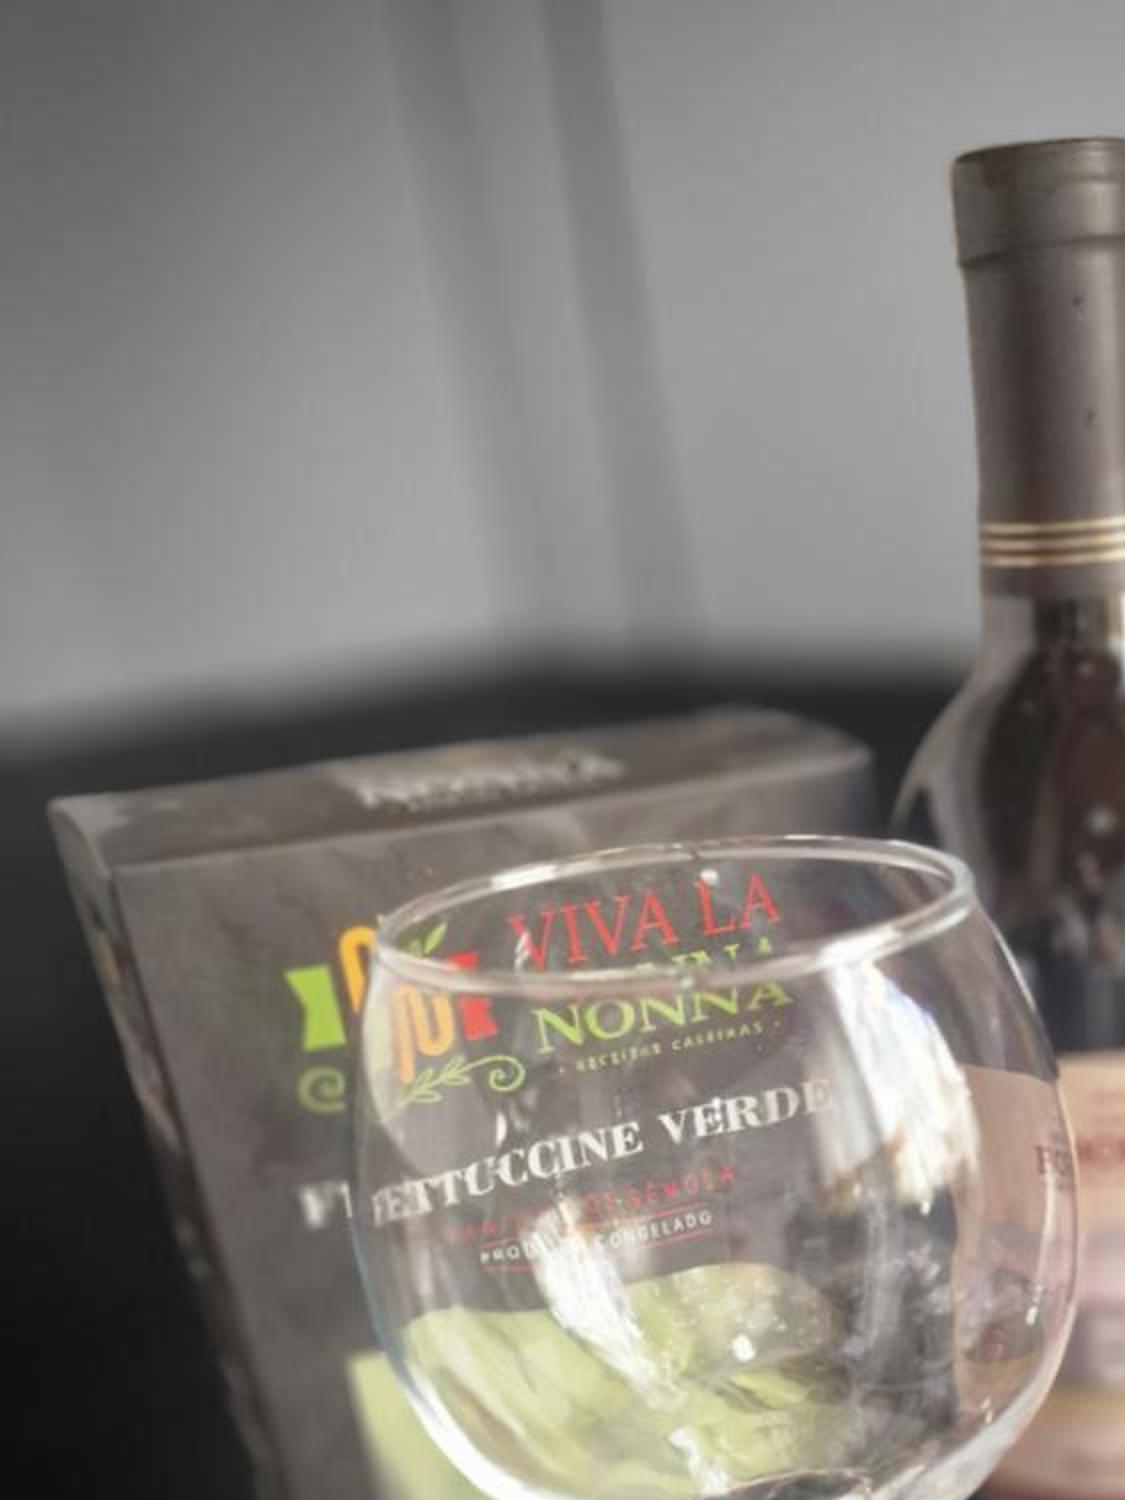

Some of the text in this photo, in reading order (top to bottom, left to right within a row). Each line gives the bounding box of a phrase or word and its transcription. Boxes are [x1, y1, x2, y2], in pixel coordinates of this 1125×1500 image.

[508, 871, 782, 974] VIVA LA
[531, 980, 794, 1054] NONNA
[659, 1079, 835, 1145] VERDE
